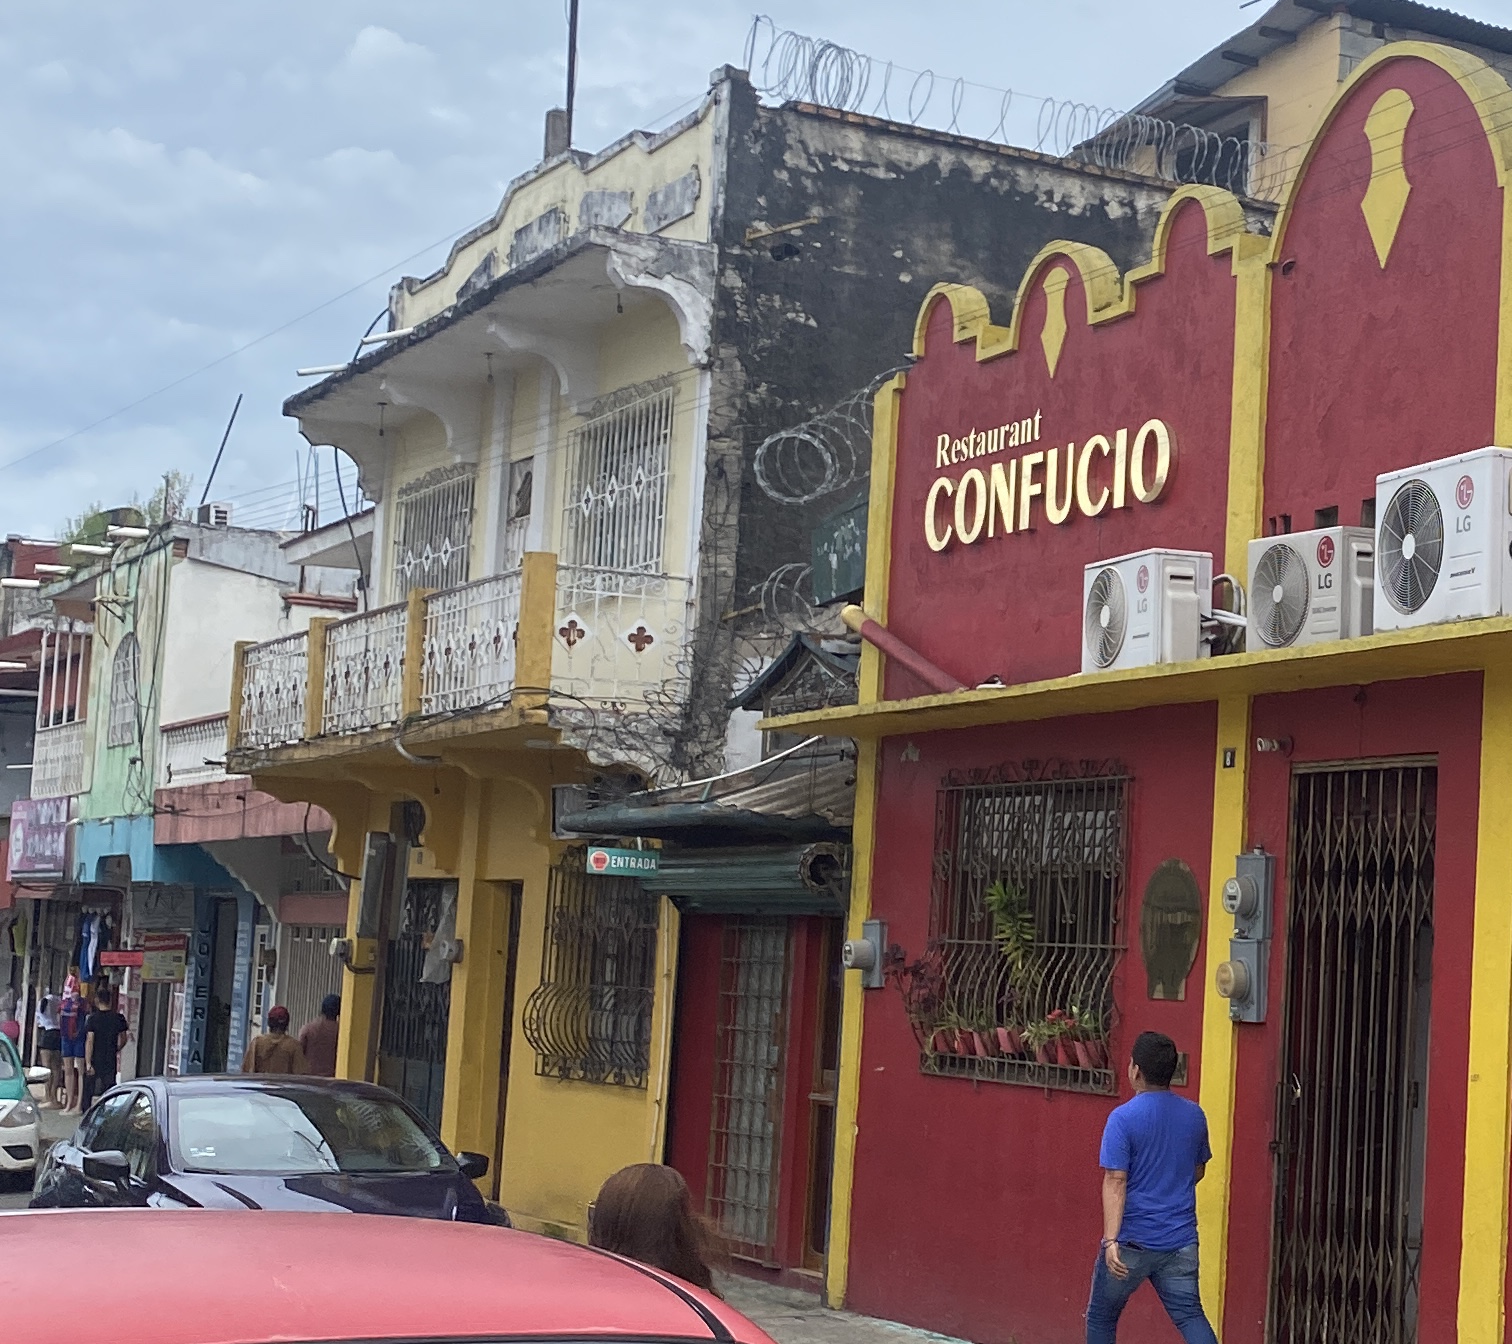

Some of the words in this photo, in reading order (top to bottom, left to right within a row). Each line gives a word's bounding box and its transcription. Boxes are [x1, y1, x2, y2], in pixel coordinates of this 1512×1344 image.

[935, 407, 1043, 468] Restaurant
[924, 418, 1174, 552] CONFUCIO
[1455, 515, 1471, 534] LG
[1317, 572, 1333, 590] LG
[1137, 597, 1148, 614] LG
[611, 856, 656, 870] ENTRADA
[189, 921, 211, 1064] JOYERIA
